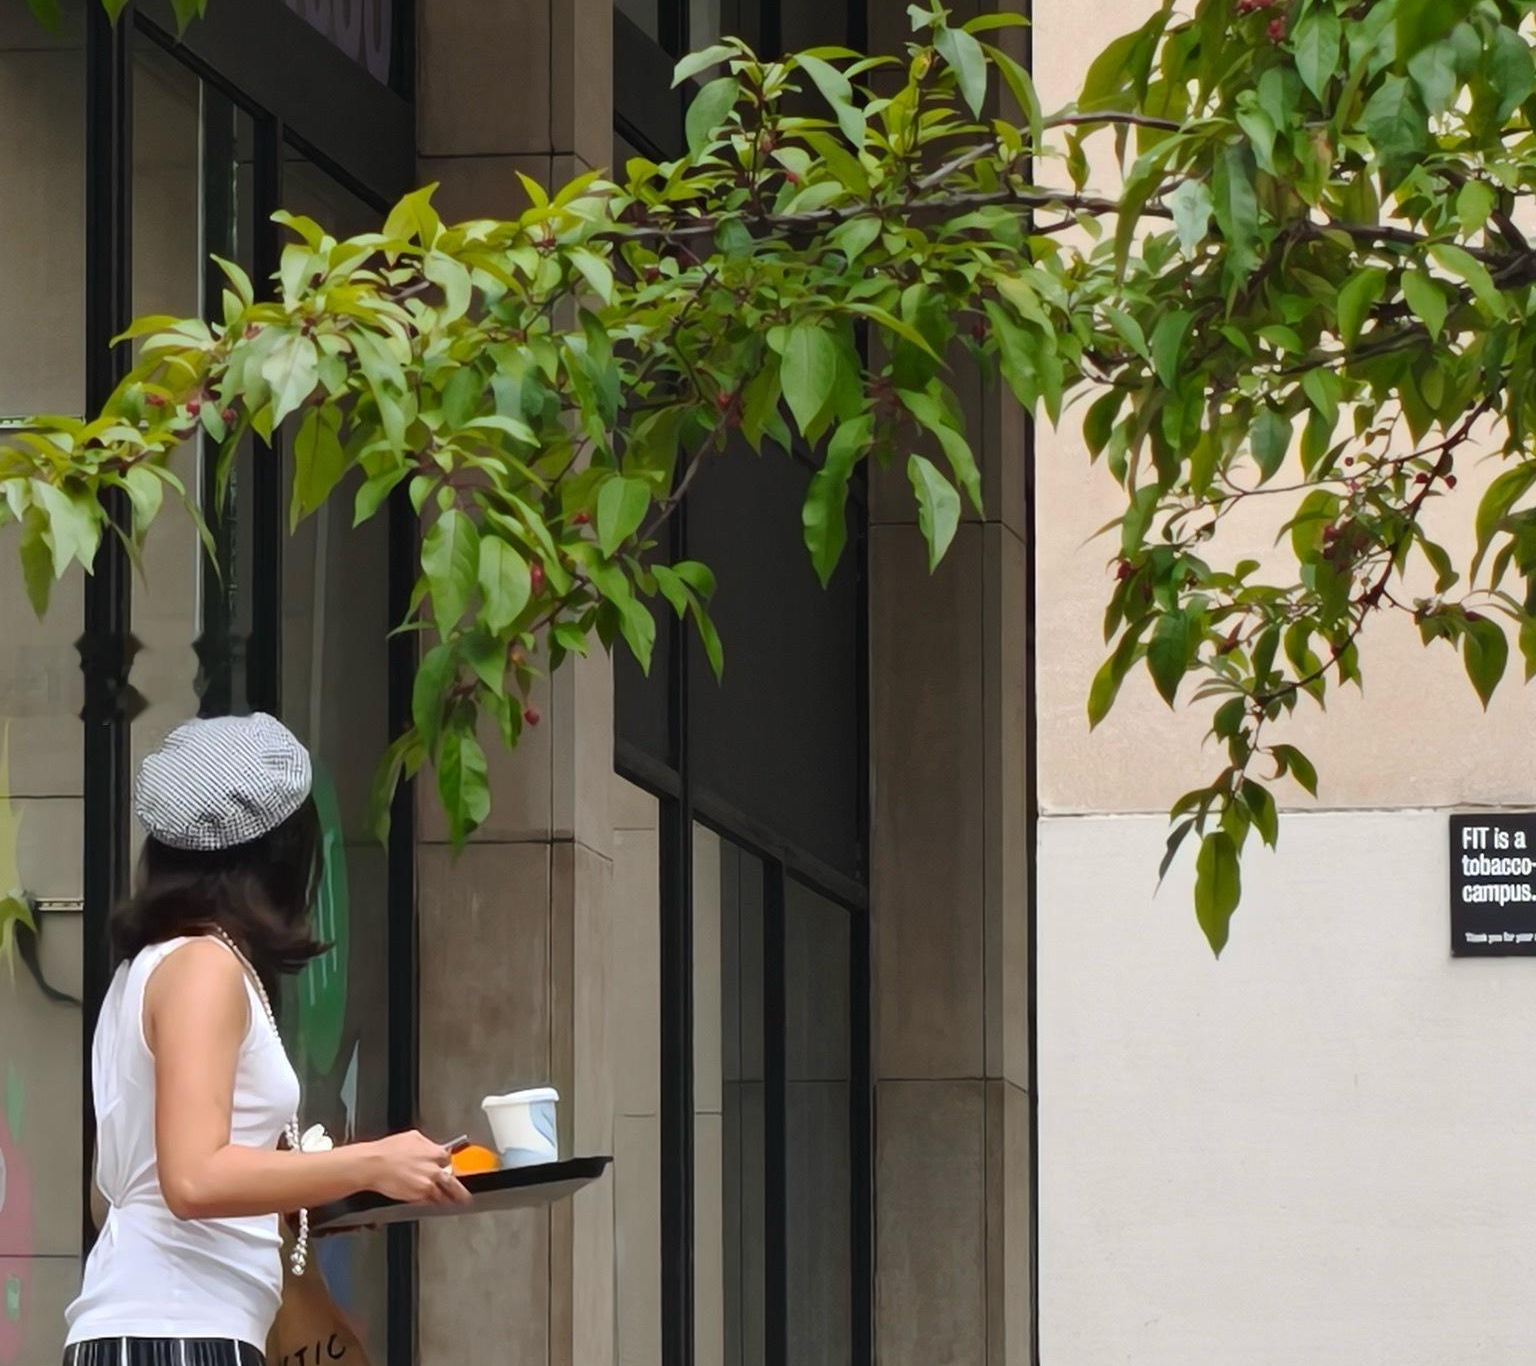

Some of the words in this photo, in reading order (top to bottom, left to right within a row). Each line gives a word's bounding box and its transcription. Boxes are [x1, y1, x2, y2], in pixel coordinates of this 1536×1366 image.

[1461, 826, 1489, 850] FIT
[1493, 826, 1510, 850] is
[1513, 830, 1527, 850] a
[1461, 883, 1536, 907] campus.
